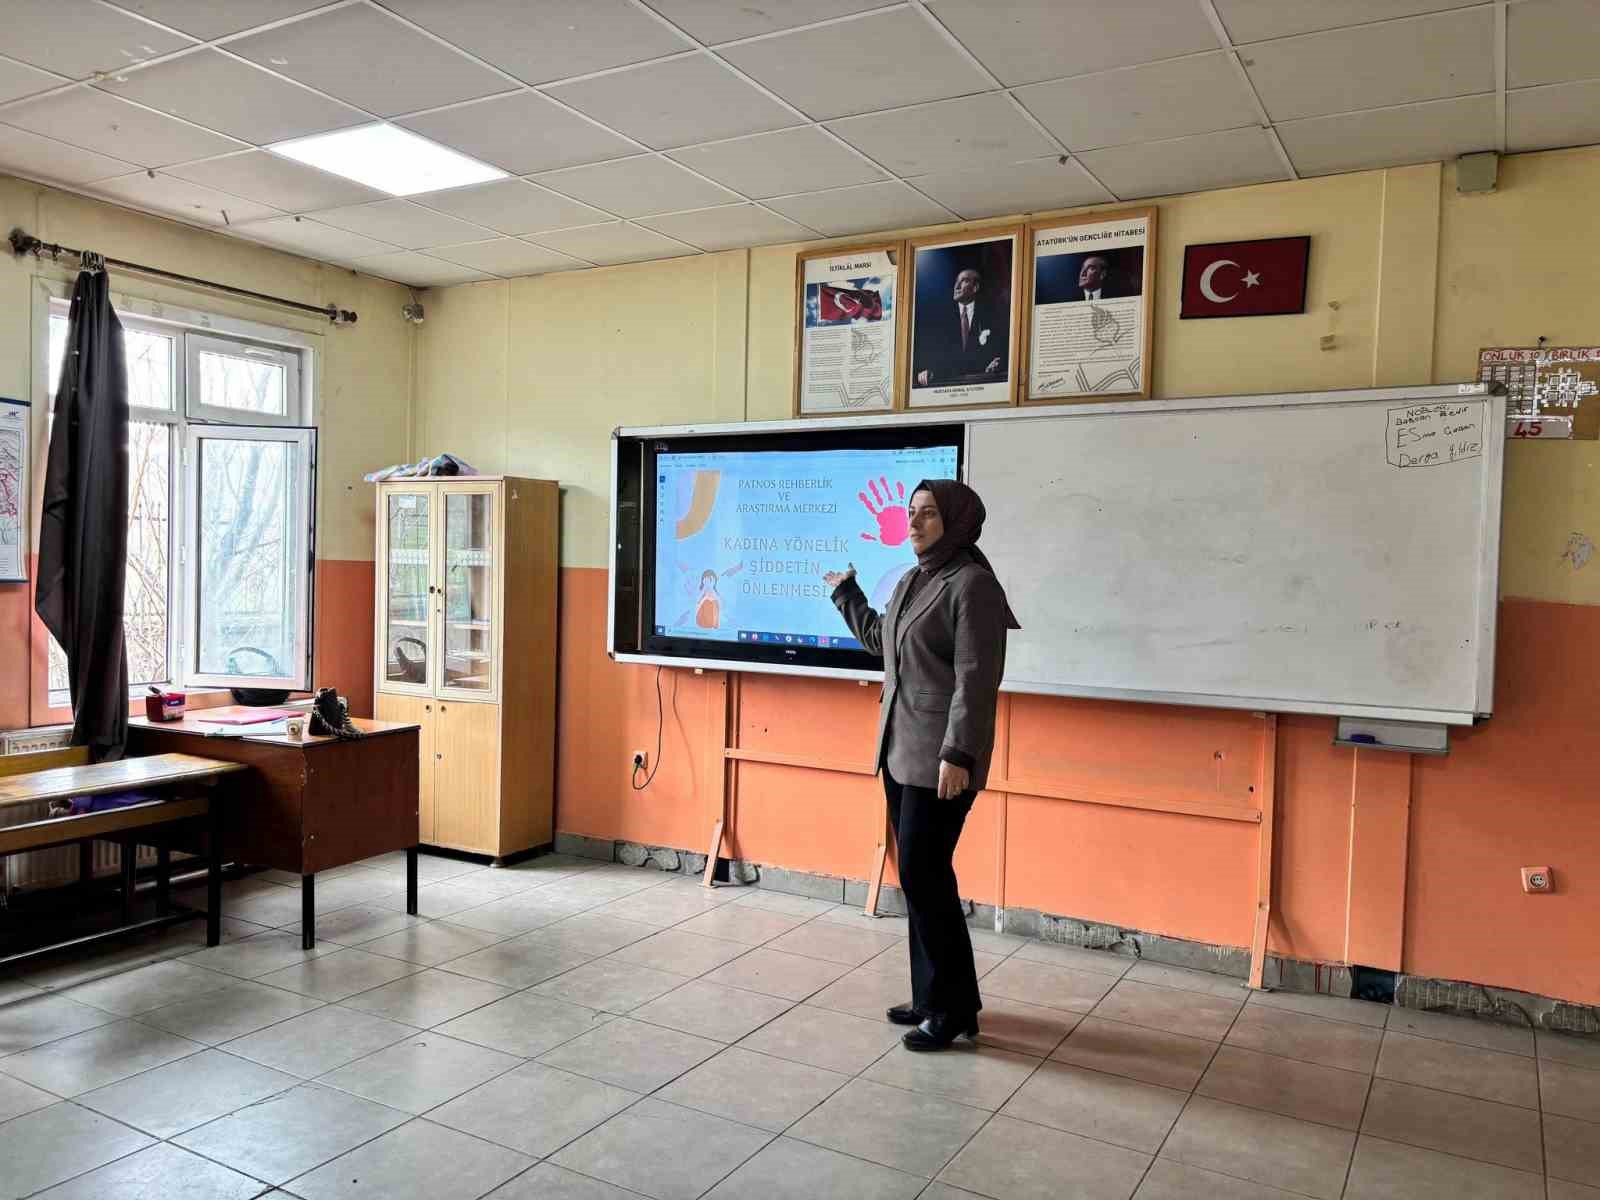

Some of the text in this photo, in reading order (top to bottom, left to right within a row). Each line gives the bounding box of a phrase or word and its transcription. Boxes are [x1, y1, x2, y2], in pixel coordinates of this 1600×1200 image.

[738, 477, 833, 489] PATNOS REHBERLİK
[777, 491, 792, 501] VE
[736, 503, 791, 515] ARAŞTIRMA
[723, 535, 849, 552] KADINA YÖNELİK
[750, 557, 820, 575] ŞİDDETİN
